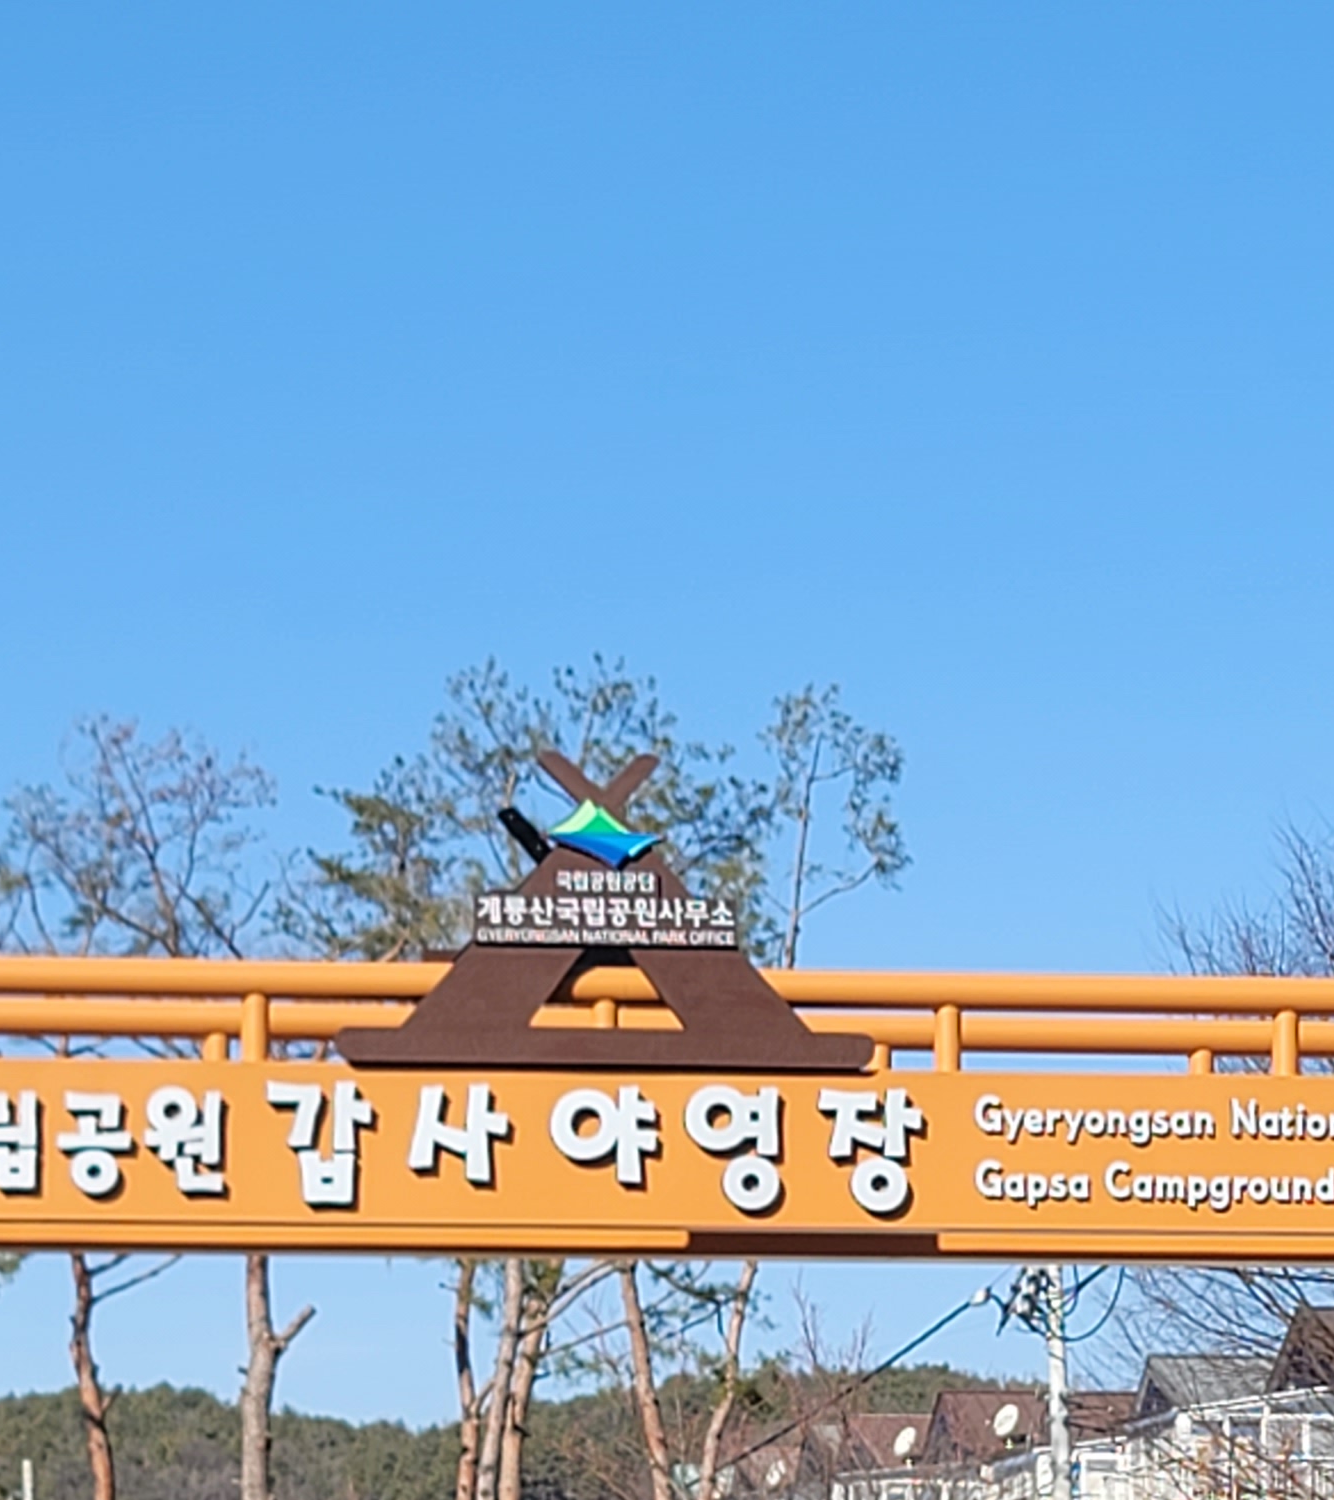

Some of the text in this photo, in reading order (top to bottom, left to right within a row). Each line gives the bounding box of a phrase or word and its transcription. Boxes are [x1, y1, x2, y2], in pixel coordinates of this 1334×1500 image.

[556, 869, 655, 893] 국립공원공단
[476, 896, 735, 928] 계룡산국립공원사무소
[581, 929, 650, 945] NATIONAL
[652, 930, 687, 945] PARK
[689, 931, 735, 946] OFFICE
[974, 1094, 1215, 1145] Gyeryongsan
[974, 1159, 1090, 1206] Gapsa
